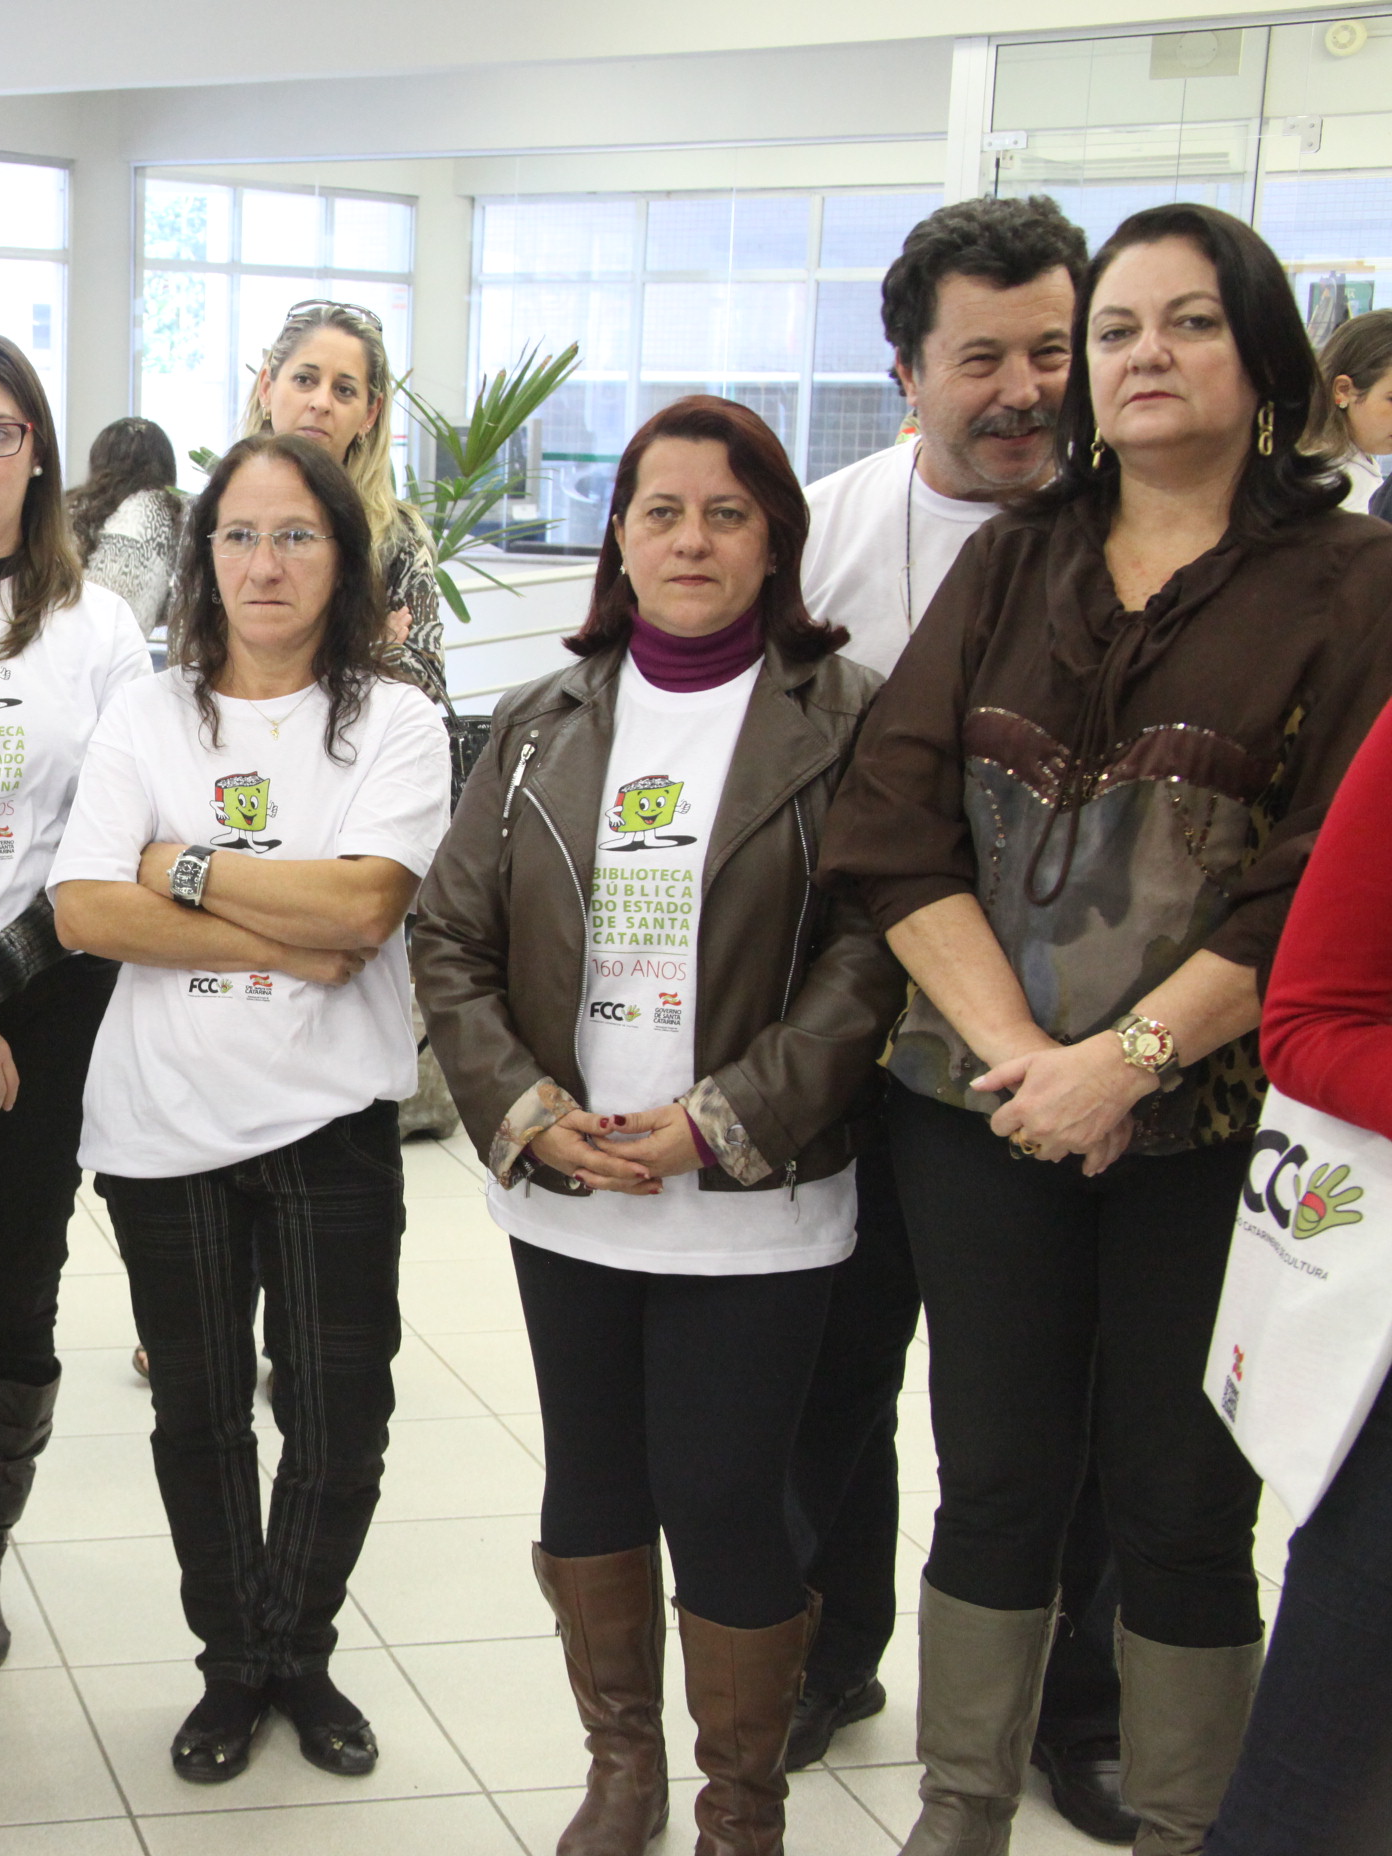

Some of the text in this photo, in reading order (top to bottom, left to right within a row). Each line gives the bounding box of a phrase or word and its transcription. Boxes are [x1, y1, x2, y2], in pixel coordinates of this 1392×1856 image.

[592, 867, 694, 882] BIBLIOTECA
[591, 881, 693, 898] PÚBLICA
[592, 899, 693, 914] DO ESTADO
[592, 915, 690, 930] DE SANTA
[592, 931, 689, 947] CATARINA
[592, 958, 687, 981] 160 ANOS
[189, 977, 219, 993] FCC
[589, 1001, 626, 1022] FCC
[654, 1007, 682, 1015] GOVERNO
[662, 1013, 681, 1021] SANTA
